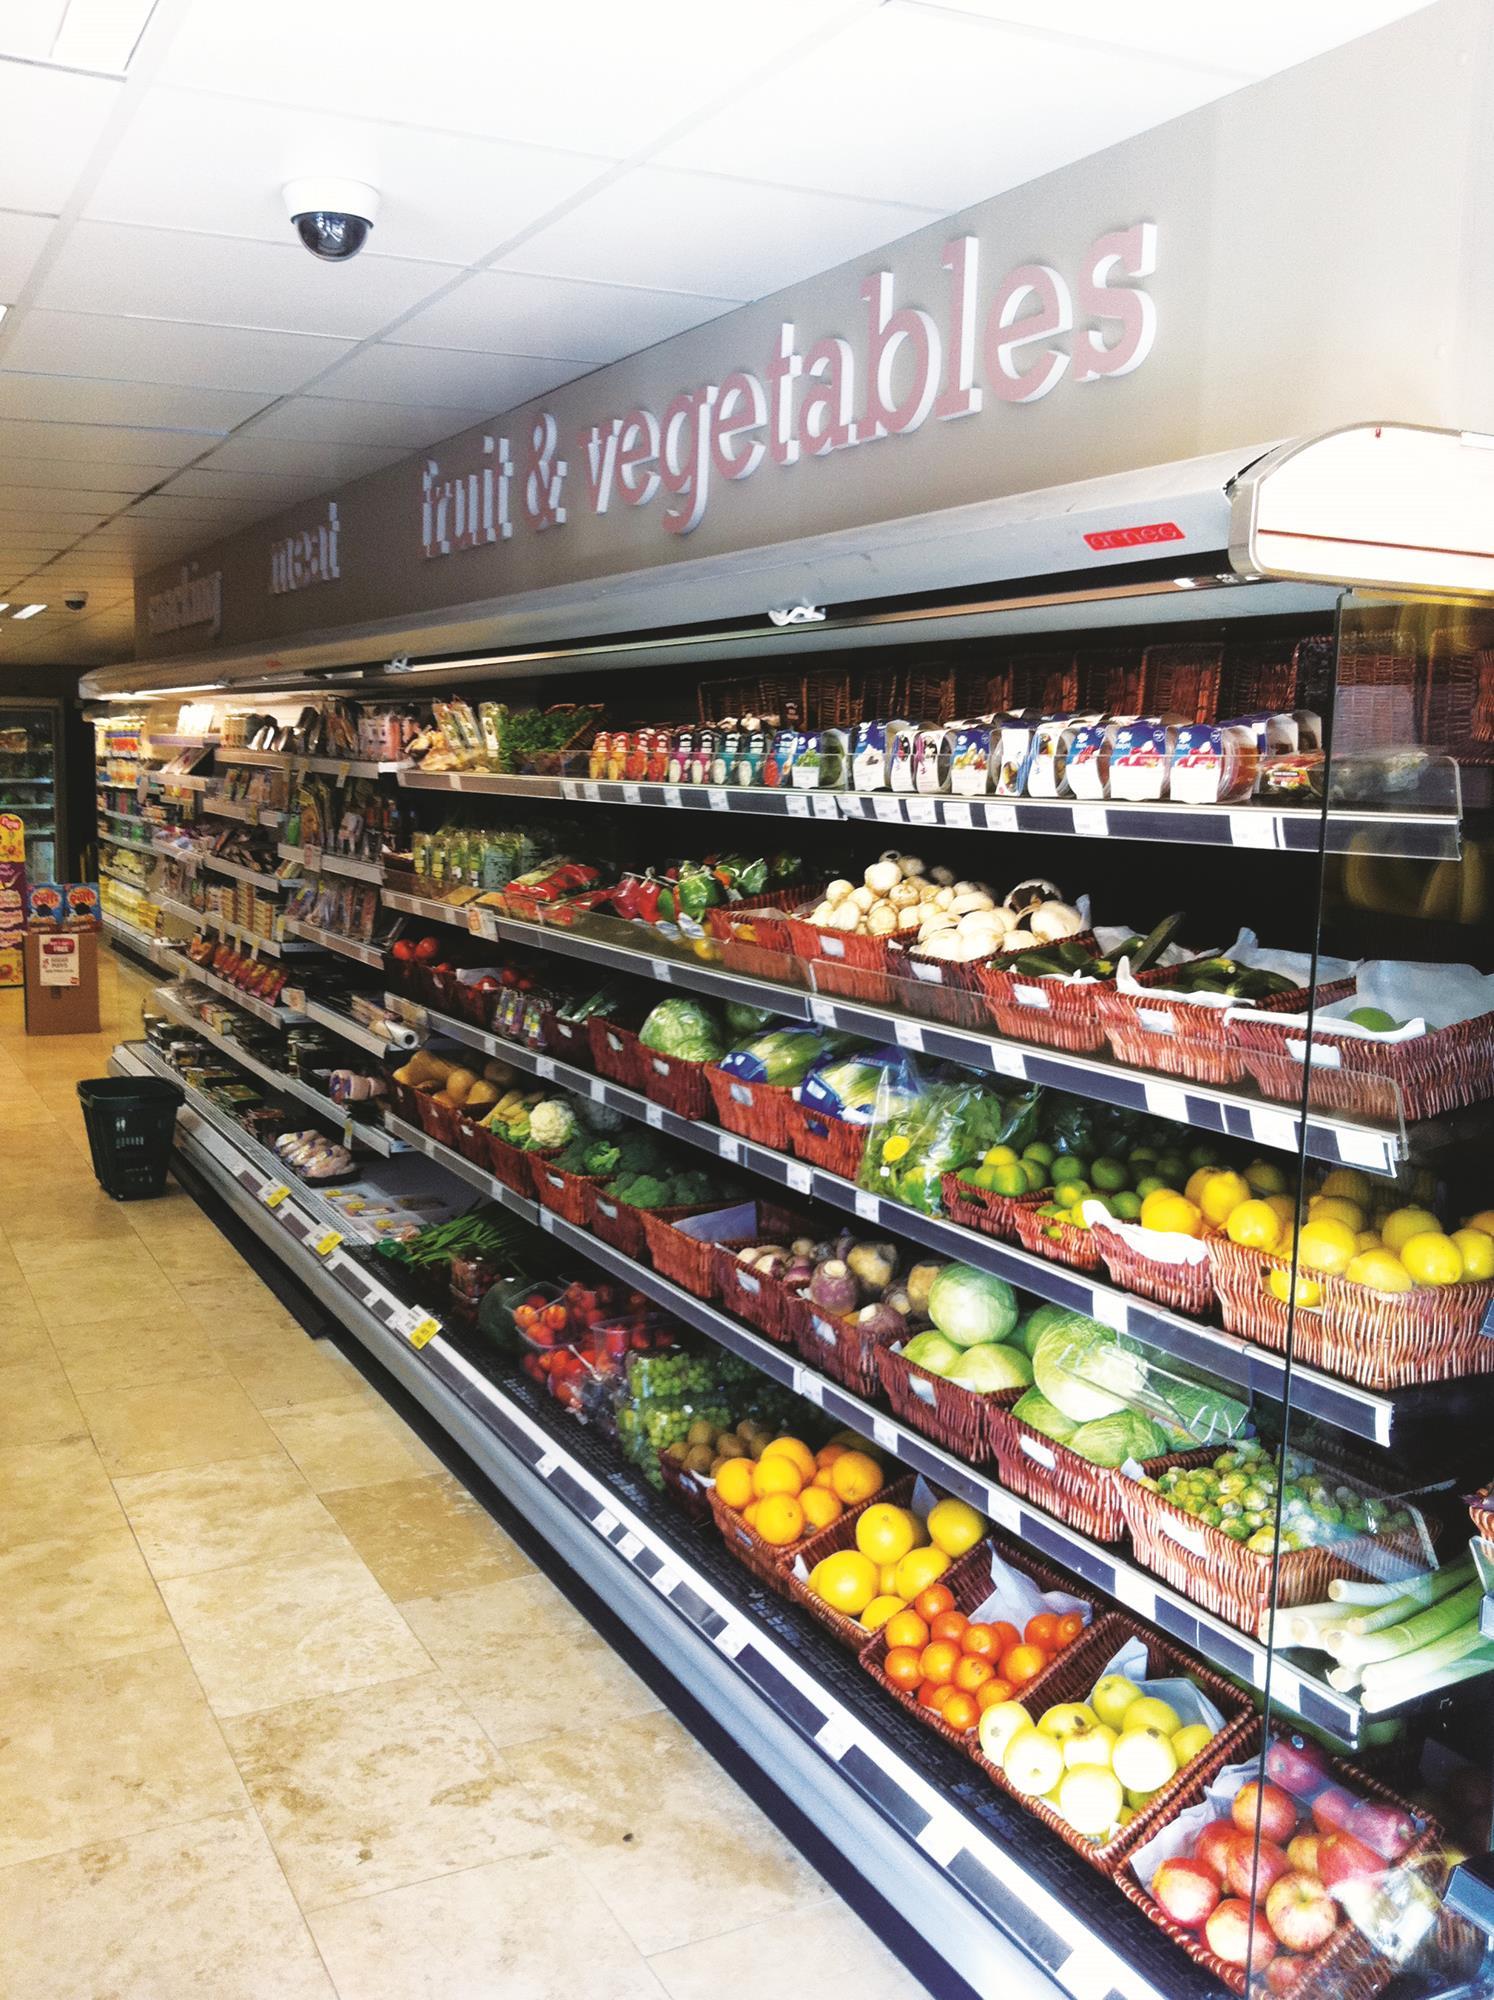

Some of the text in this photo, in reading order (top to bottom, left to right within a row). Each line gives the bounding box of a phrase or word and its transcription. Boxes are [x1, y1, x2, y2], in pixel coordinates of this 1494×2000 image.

[420, 222, 1158, 558] fruit & vegetables
